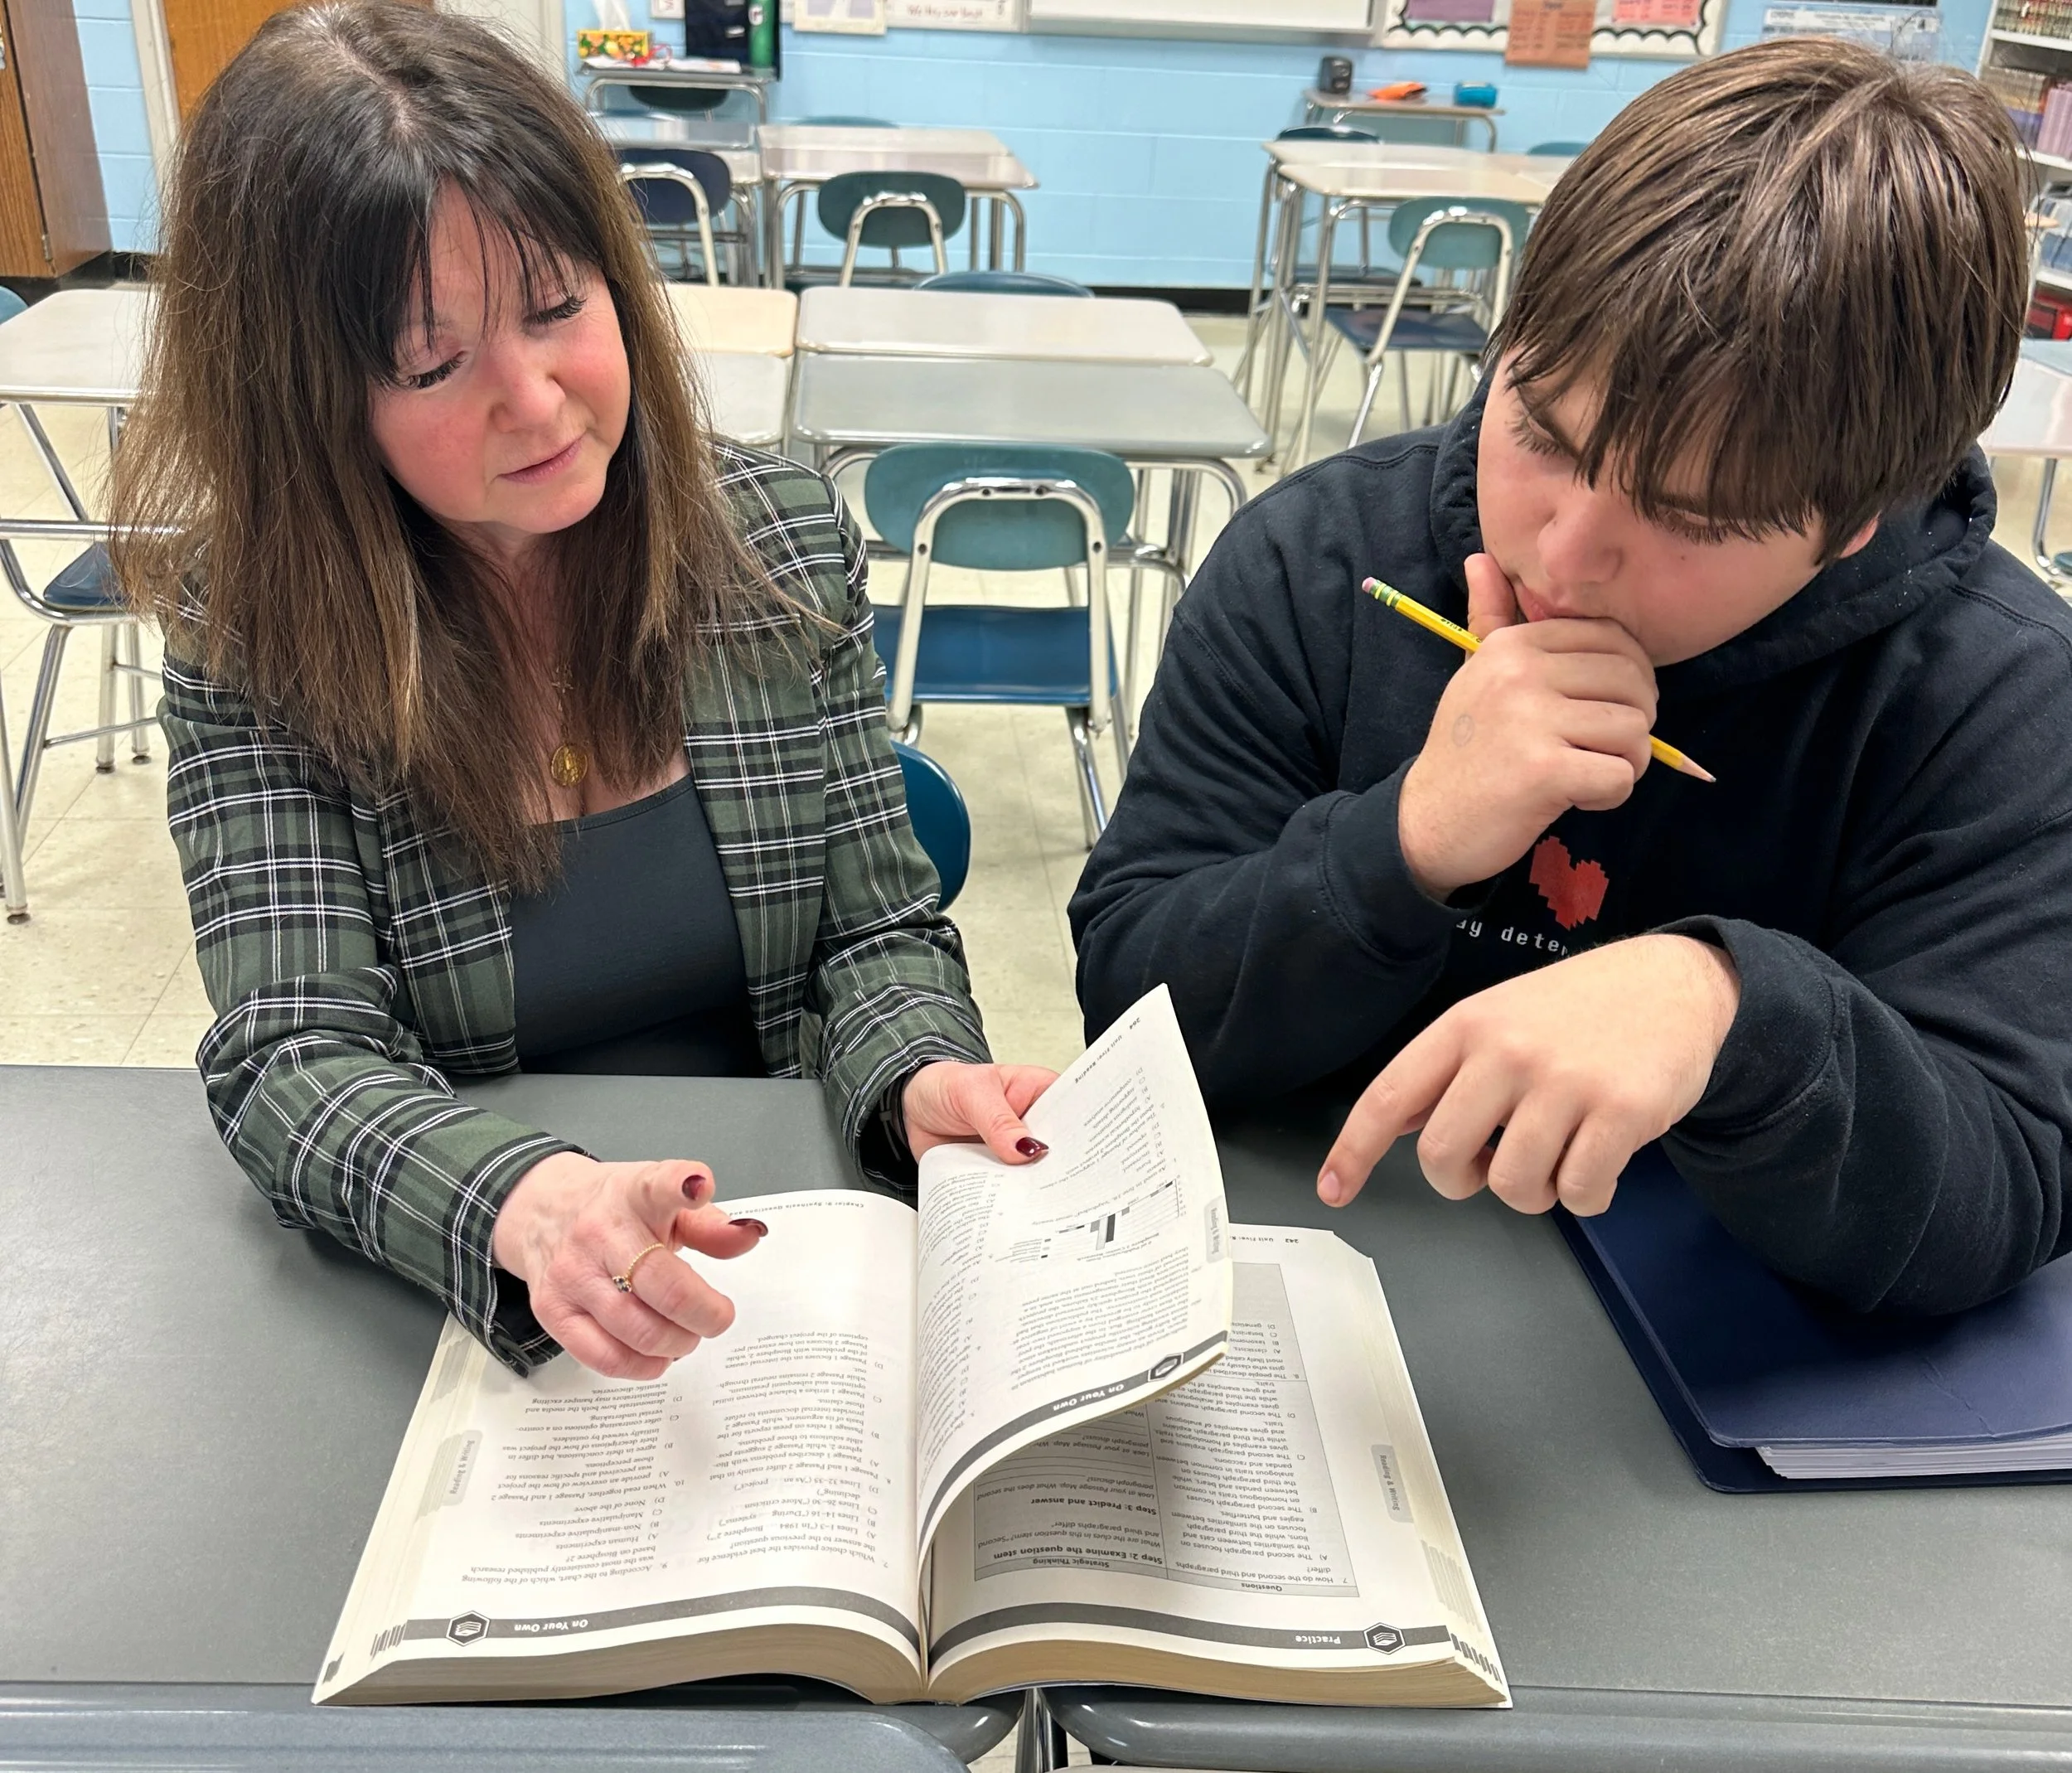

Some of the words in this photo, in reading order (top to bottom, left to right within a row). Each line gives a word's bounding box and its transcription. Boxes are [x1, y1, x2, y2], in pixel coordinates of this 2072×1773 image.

[1130, 1018, 1140, 1029] 264
[1111, 1035, 1122, 1048] Unit
[745, 1205, 782, 1213] Questions
[1109, 1384, 1124, 1393] On
[1080, 1391, 1106, 1402] Your
[1053, 1398, 1077, 1411] Own
[1078, 1484, 1110, 1493] Passage
[1116, 1480, 1155, 1490] paragraph
[623, 1487, 641, 1495] read
[976, 1489, 1003, 1502] second
[498, 1494, 530, 1502] Passage
[1087, 1500, 1122, 1510] Predict
[1134, 1505, 1157, 1515] Step
[540, 1518, 590, 1526] experiments
[591, 1512, 644, 1523] Manipulative
[1172, 1512, 1206, 1524] between
[1077, 1523, 1122, 1532] paragraphs
[1206, 1518, 1248, 1528] similarities
[567, 1524, 641, 1537] Non-manipulative
[1123, 1528, 1144, 1536] third
[1186, 1524, 1227, 1534] paragraph
[1276, 1525, 1306, 1533] focuses
[516, 1531, 567, 1539] experiments
[1092, 1533, 1113, 1542] clues
[556, 1539, 608, 1550] experiments
[608, 1536, 639, 1544] Human
[834, 1538, 863, 1547] answer
[1140, 1539, 1160, 1548] What
[1216, 1538, 1253, 1548] between
[632, 1546, 656, 1555] based
[821, 1546, 848, 1555] choice
[863, 1543, 876, 1553] the
[1020, 1545, 1063, 1554] question
[1192, 1543, 1223, 1553] focuses
[1252, 1542, 1296, 1550] similarities
[711, 1550, 748, 1561] evidence
[994, 1550, 1018, 1559] stem
[1066, 1547, 1083, 1555] the
[1085, 1548, 1127, 1559] Examine
[1223, 1548, 1265, 1557] paragraph
[577, 1552, 618, 1561] Biosphere
[848, 1550, 875, 1563] Which
[1140, 1554, 1162, 1565] Step
[551, 1562, 600, 1573] consistently
[601, 1560, 622, 1568] most
[1072, 1558, 1110, 1568] Strategic
[1175, 1562, 1220, 1573] paragraphs
[508, 1566, 549, 1575] published
[609, 1565, 652, 1576] According
[1221, 1569, 1240, 1577] third
[462, 1575, 502, 1585] following
[1241, 1583, 1282, 1592] Questions
[514, 1624, 540, 1632] Own
[543, 1622, 569, 1630] Your
[572, 1620, 588, 1628] On
[1295, 1635, 1341, 1645] Practice
